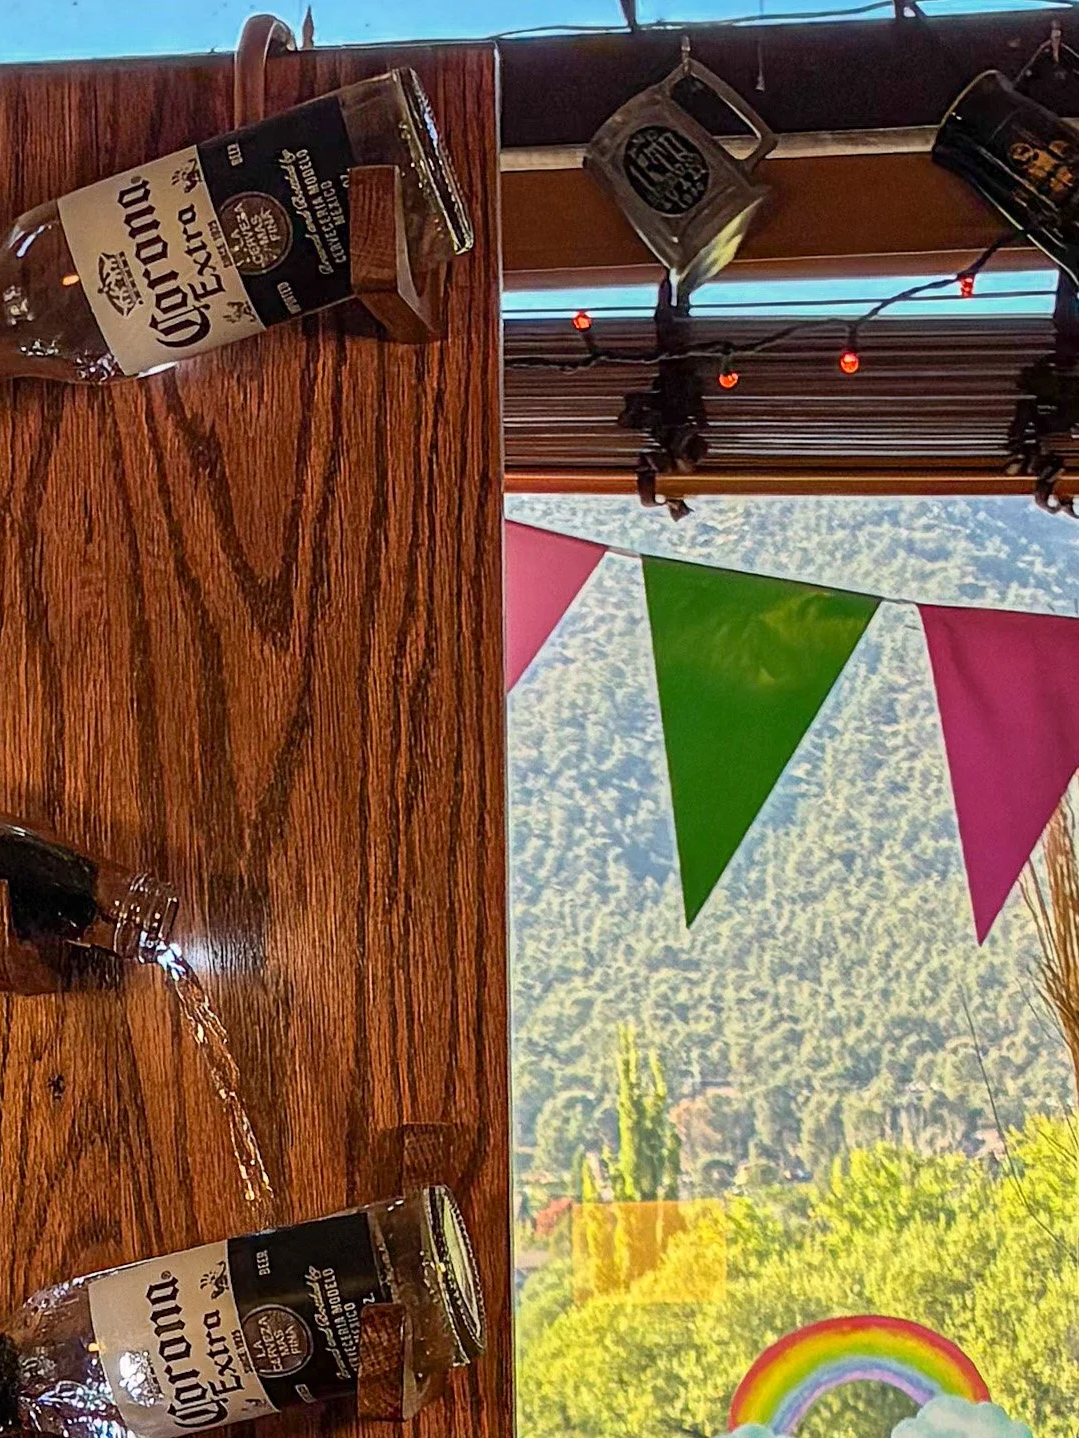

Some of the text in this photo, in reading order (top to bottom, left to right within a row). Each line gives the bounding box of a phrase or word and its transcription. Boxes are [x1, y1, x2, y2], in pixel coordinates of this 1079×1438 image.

[295, 148, 320, 195] MODELO
[320, 179, 345, 225] MEXICO
[118, 178, 211, 348] Corona
[178, 203, 225, 302] Extra
[255, 1249, 270, 1275] BEER
[322, 1267, 343, 1313] MODELO
[146, 1277, 227, 1426] Corona
[203, 1309, 244, 1396] Extra
[252, 1339, 266, 1358] LA
[258, 1315, 282, 1371] CERVEZA
[273, 1328, 290, 1356] MAS
[284, 1324, 301, 1354] FINA
